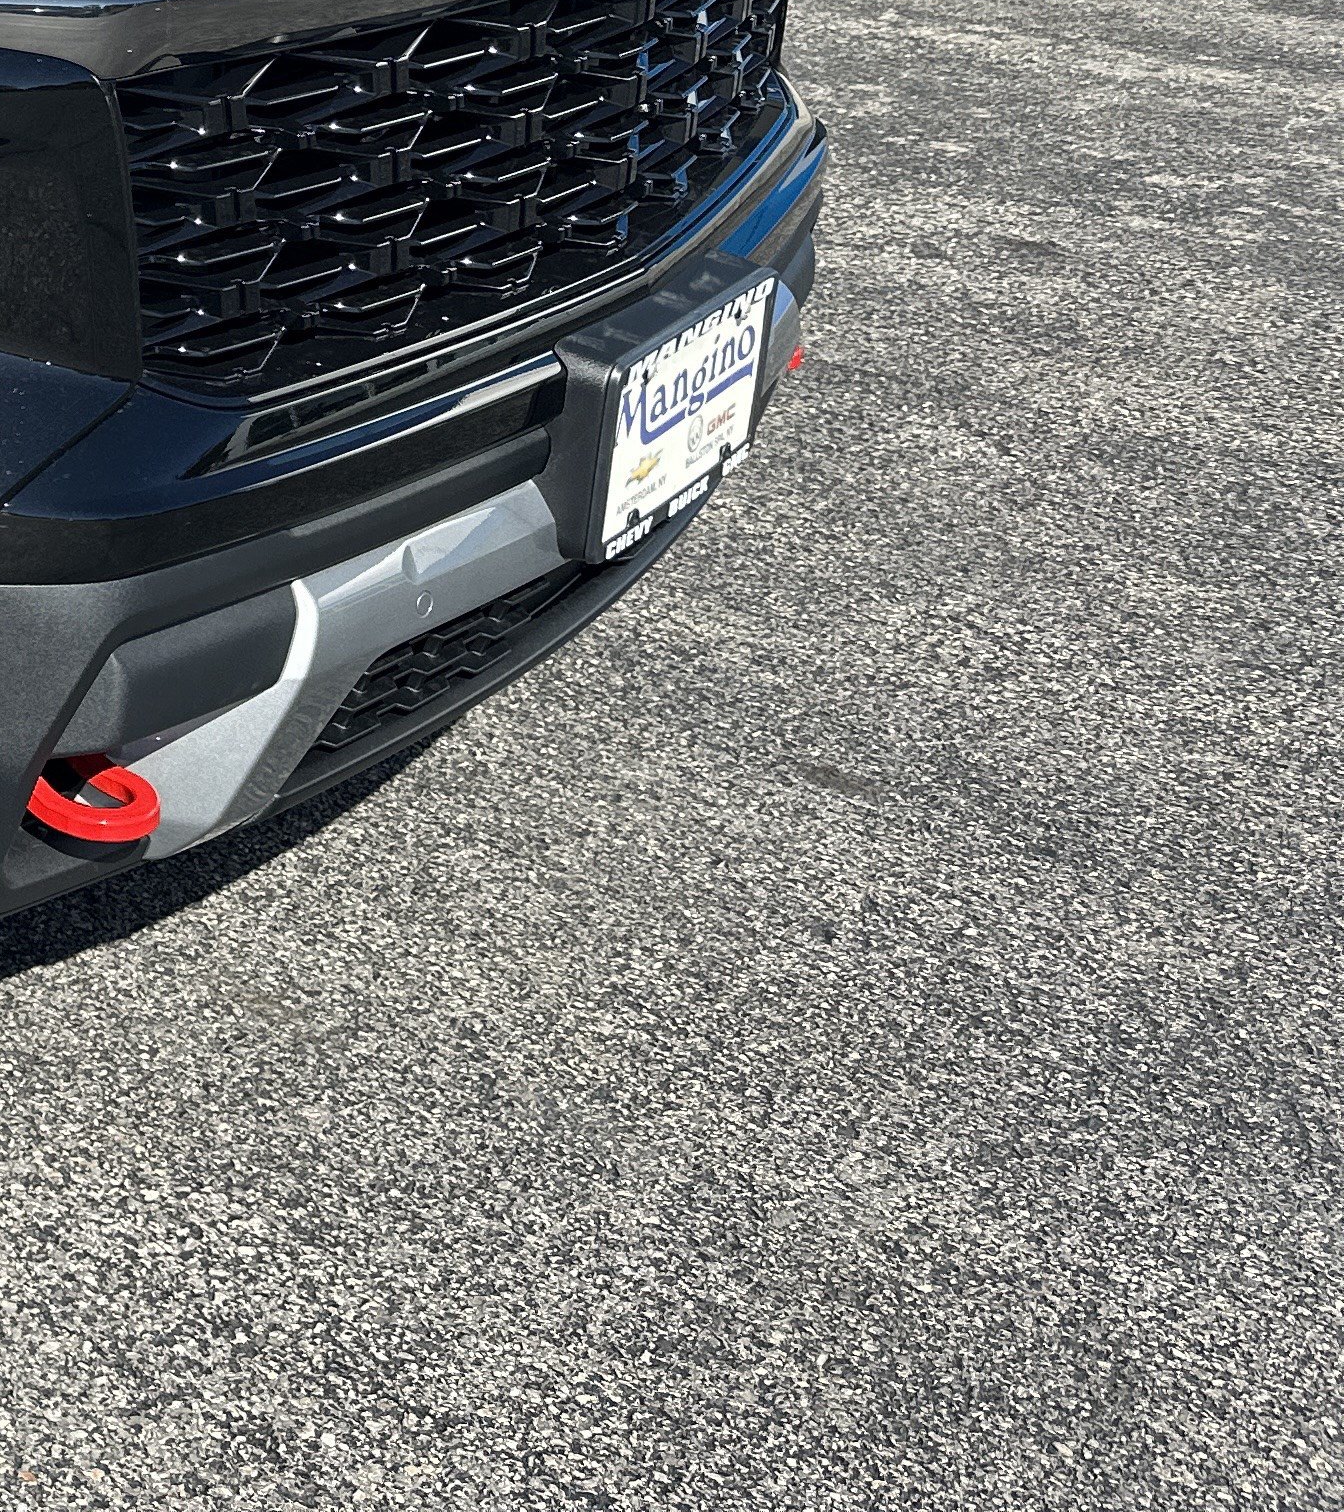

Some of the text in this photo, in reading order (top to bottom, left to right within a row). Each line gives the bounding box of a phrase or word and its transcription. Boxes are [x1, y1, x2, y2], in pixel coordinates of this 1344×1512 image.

[627, 277, 775, 383] MANGINO
[615, 325, 756, 445] Mangino
[707, 403, 736, 436] GMC
[605, 516, 653, 560] CHEVY
[668, 475, 709, 518] BUICK
